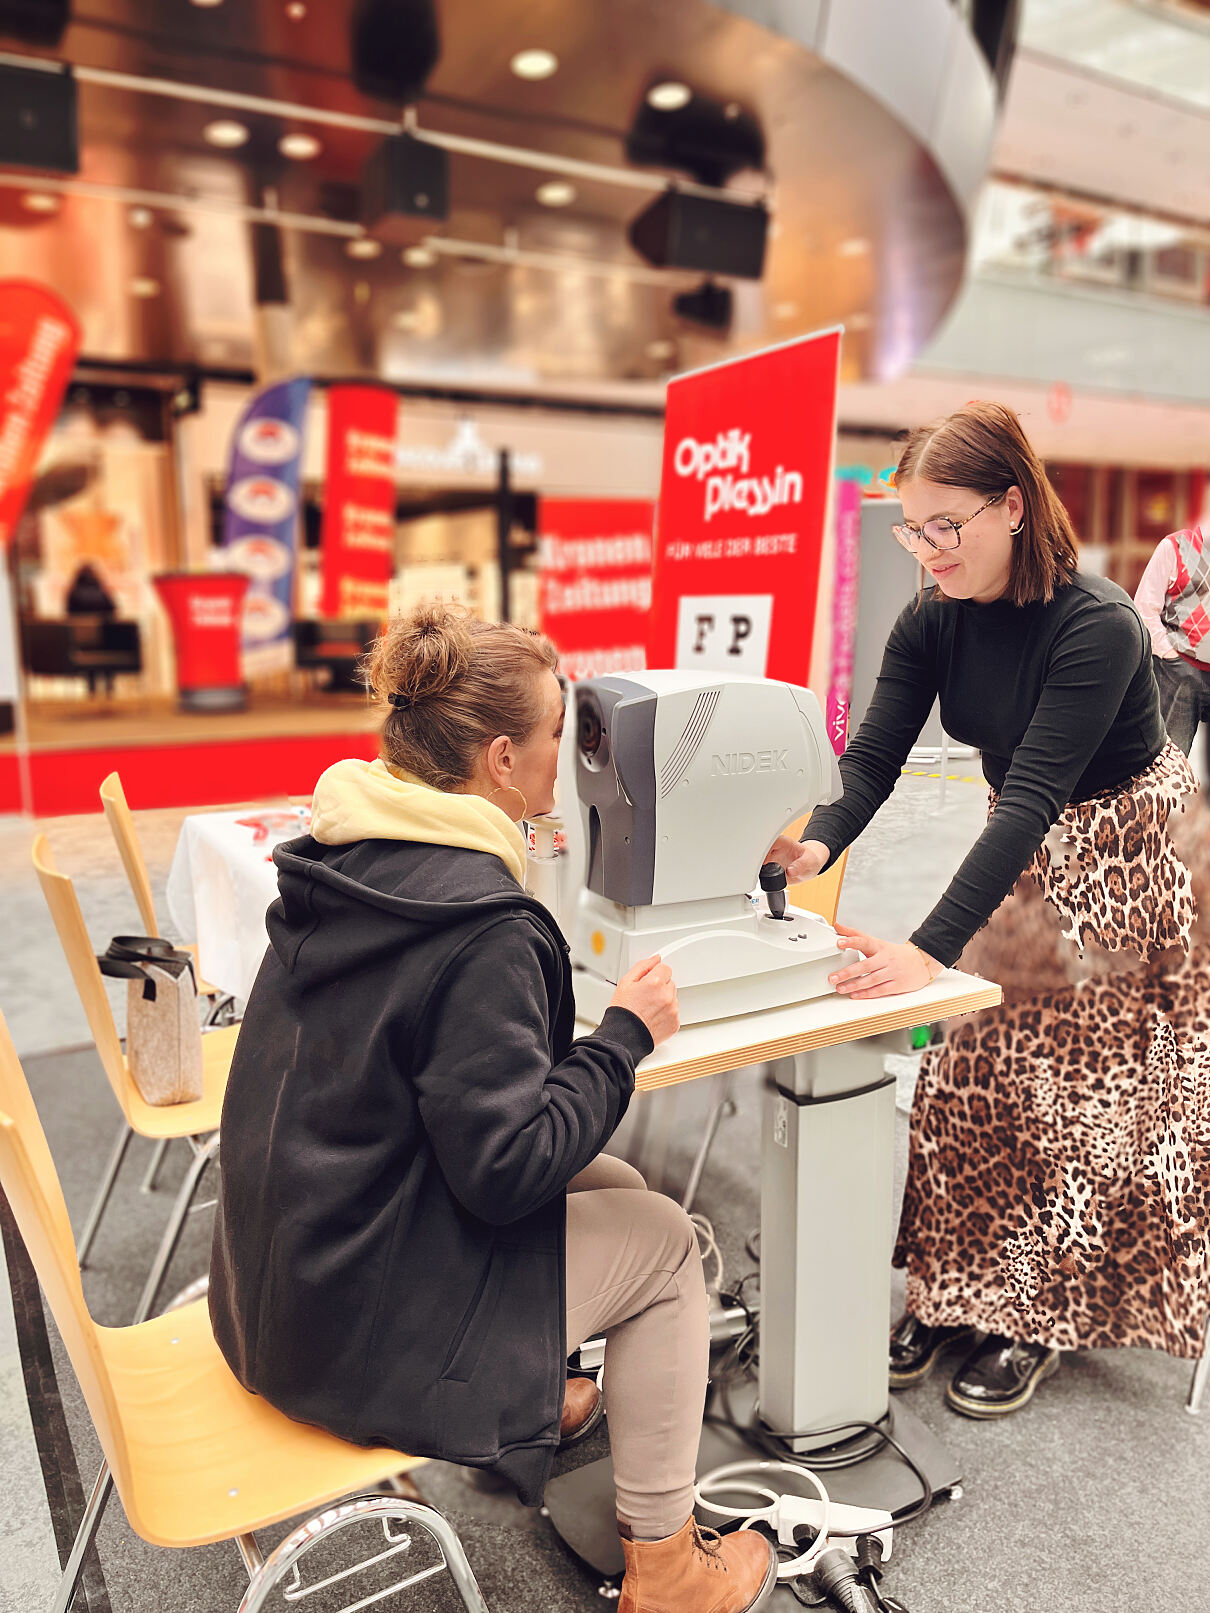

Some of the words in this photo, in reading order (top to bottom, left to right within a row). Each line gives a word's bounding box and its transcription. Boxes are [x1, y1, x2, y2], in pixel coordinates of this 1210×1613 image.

[674, 427, 752, 480] Optik
[692, 613, 716, 655] F
[727, 613, 753, 656] P
[710, 749, 792, 777] NIDEK
